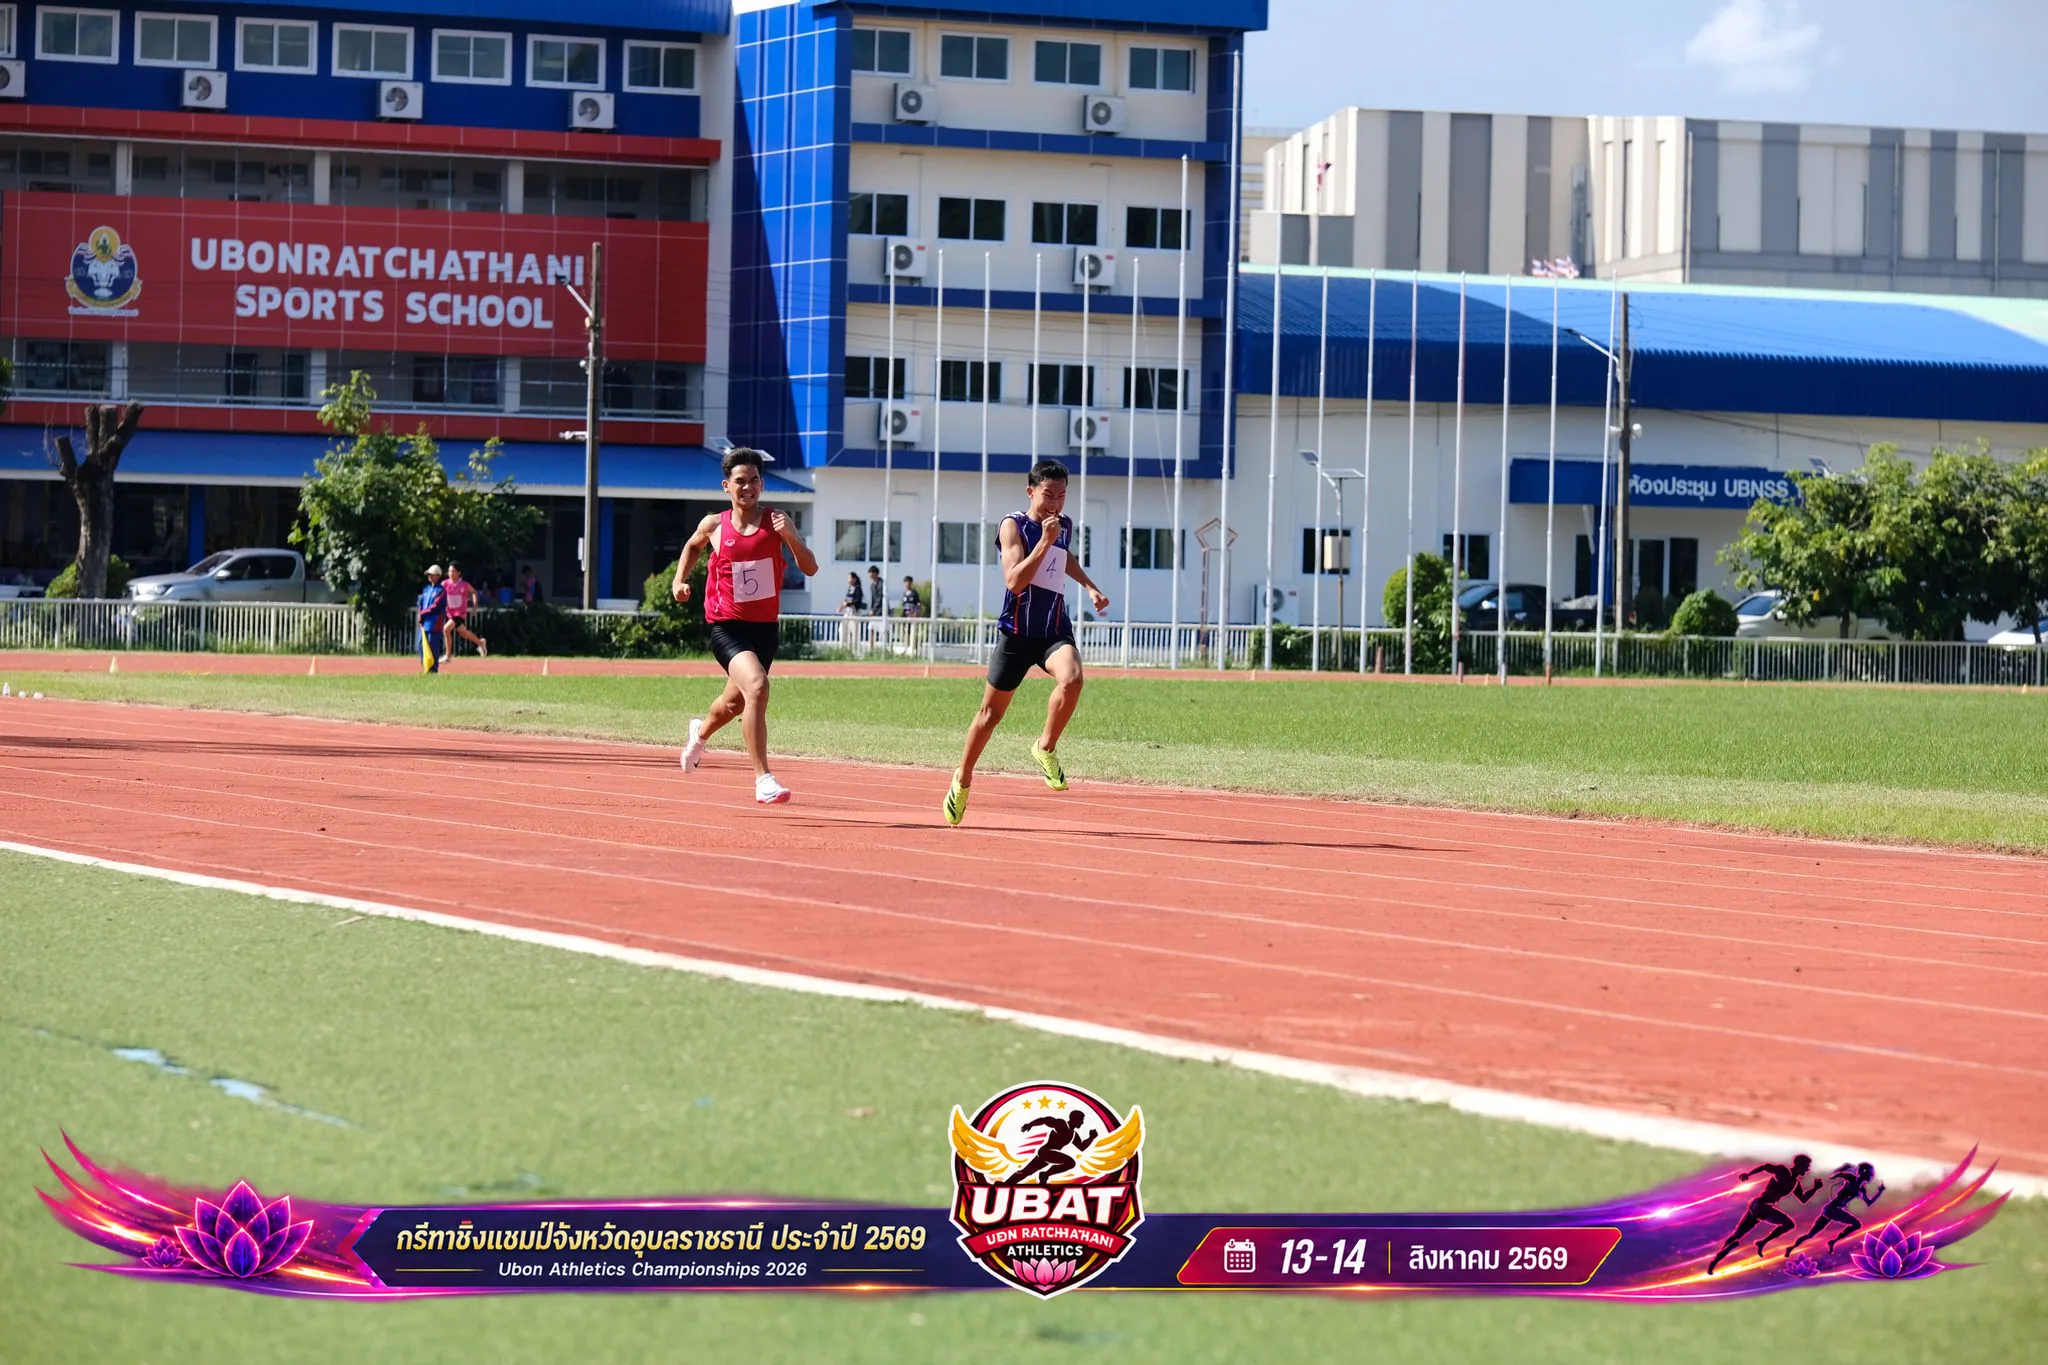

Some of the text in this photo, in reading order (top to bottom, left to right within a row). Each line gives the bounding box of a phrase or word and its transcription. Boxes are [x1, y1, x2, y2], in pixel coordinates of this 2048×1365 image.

[191, 238, 584, 286] UBONRATCHATHANI
[235, 284, 554, 329] SPORTS SCHOOL
[1724, 478, 1789, 499] UBNSS
[1046, 556, 1057, 579] 4
[742, 568, 759, 596] 5
